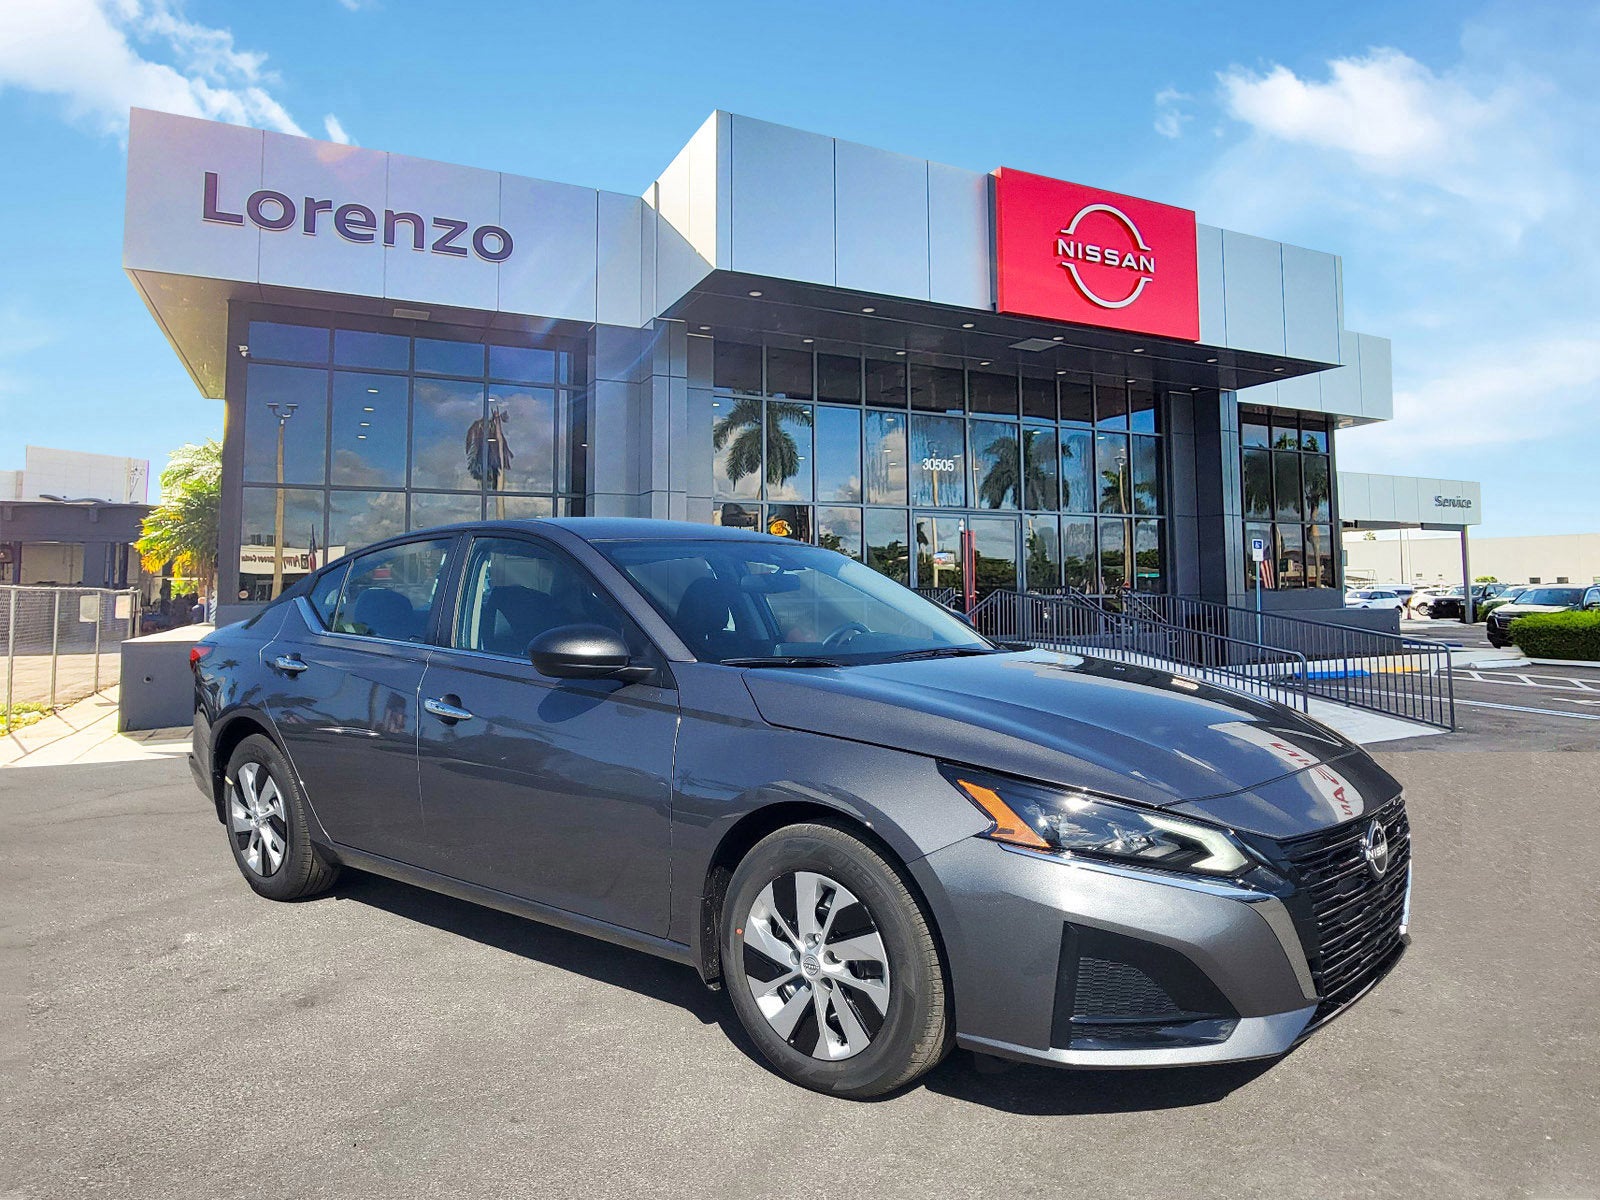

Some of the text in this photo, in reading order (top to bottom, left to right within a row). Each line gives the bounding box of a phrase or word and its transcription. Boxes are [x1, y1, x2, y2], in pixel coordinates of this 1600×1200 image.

[203, 171, 515, 262] Lorenzo
[1057, 238, 1156, 274] NISSAN
[922, 457, 955, 472] 30505
[1434, 495, 1472, 509] Service
[1366, 844, 1388, 860] NISS
